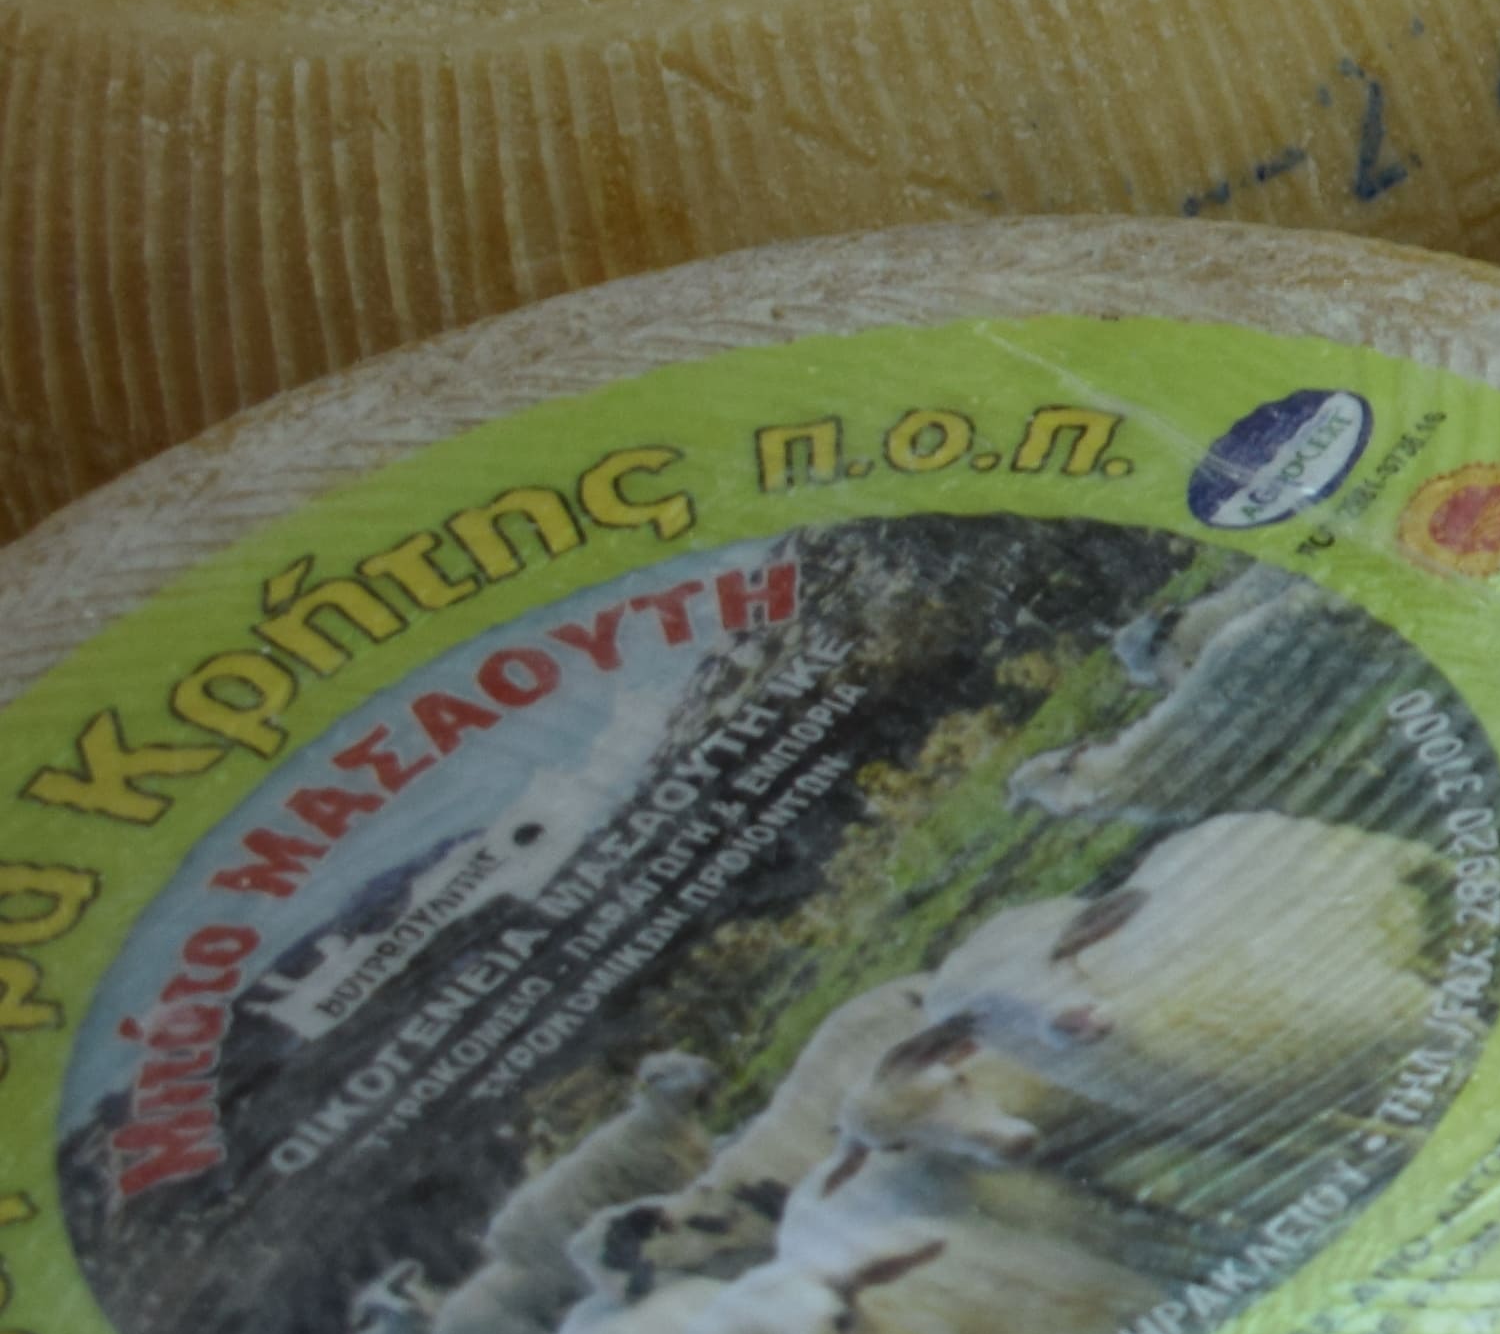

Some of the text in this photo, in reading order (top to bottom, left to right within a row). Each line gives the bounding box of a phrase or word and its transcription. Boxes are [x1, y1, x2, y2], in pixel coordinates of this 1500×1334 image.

[19, 445, 697, 825] Κρήτης
[210, 562, 799, 898] ΜΑΣΑΟΥΤΗ
[1387, 689, 1484, 801] 31000
[270, 638, 855, 1173] ΟΙΚΟΓΕΝΕΙΑ ΜΑΣΑΟΥΤΗ ΙΚΕ
[562, 819, 718, 965] ΠΑΡΑΓΩΓΗ
[735, 682, 869, 799] ΕΜΠΟΡΙΑ
[1447, 806, 1500, 928] 28920
